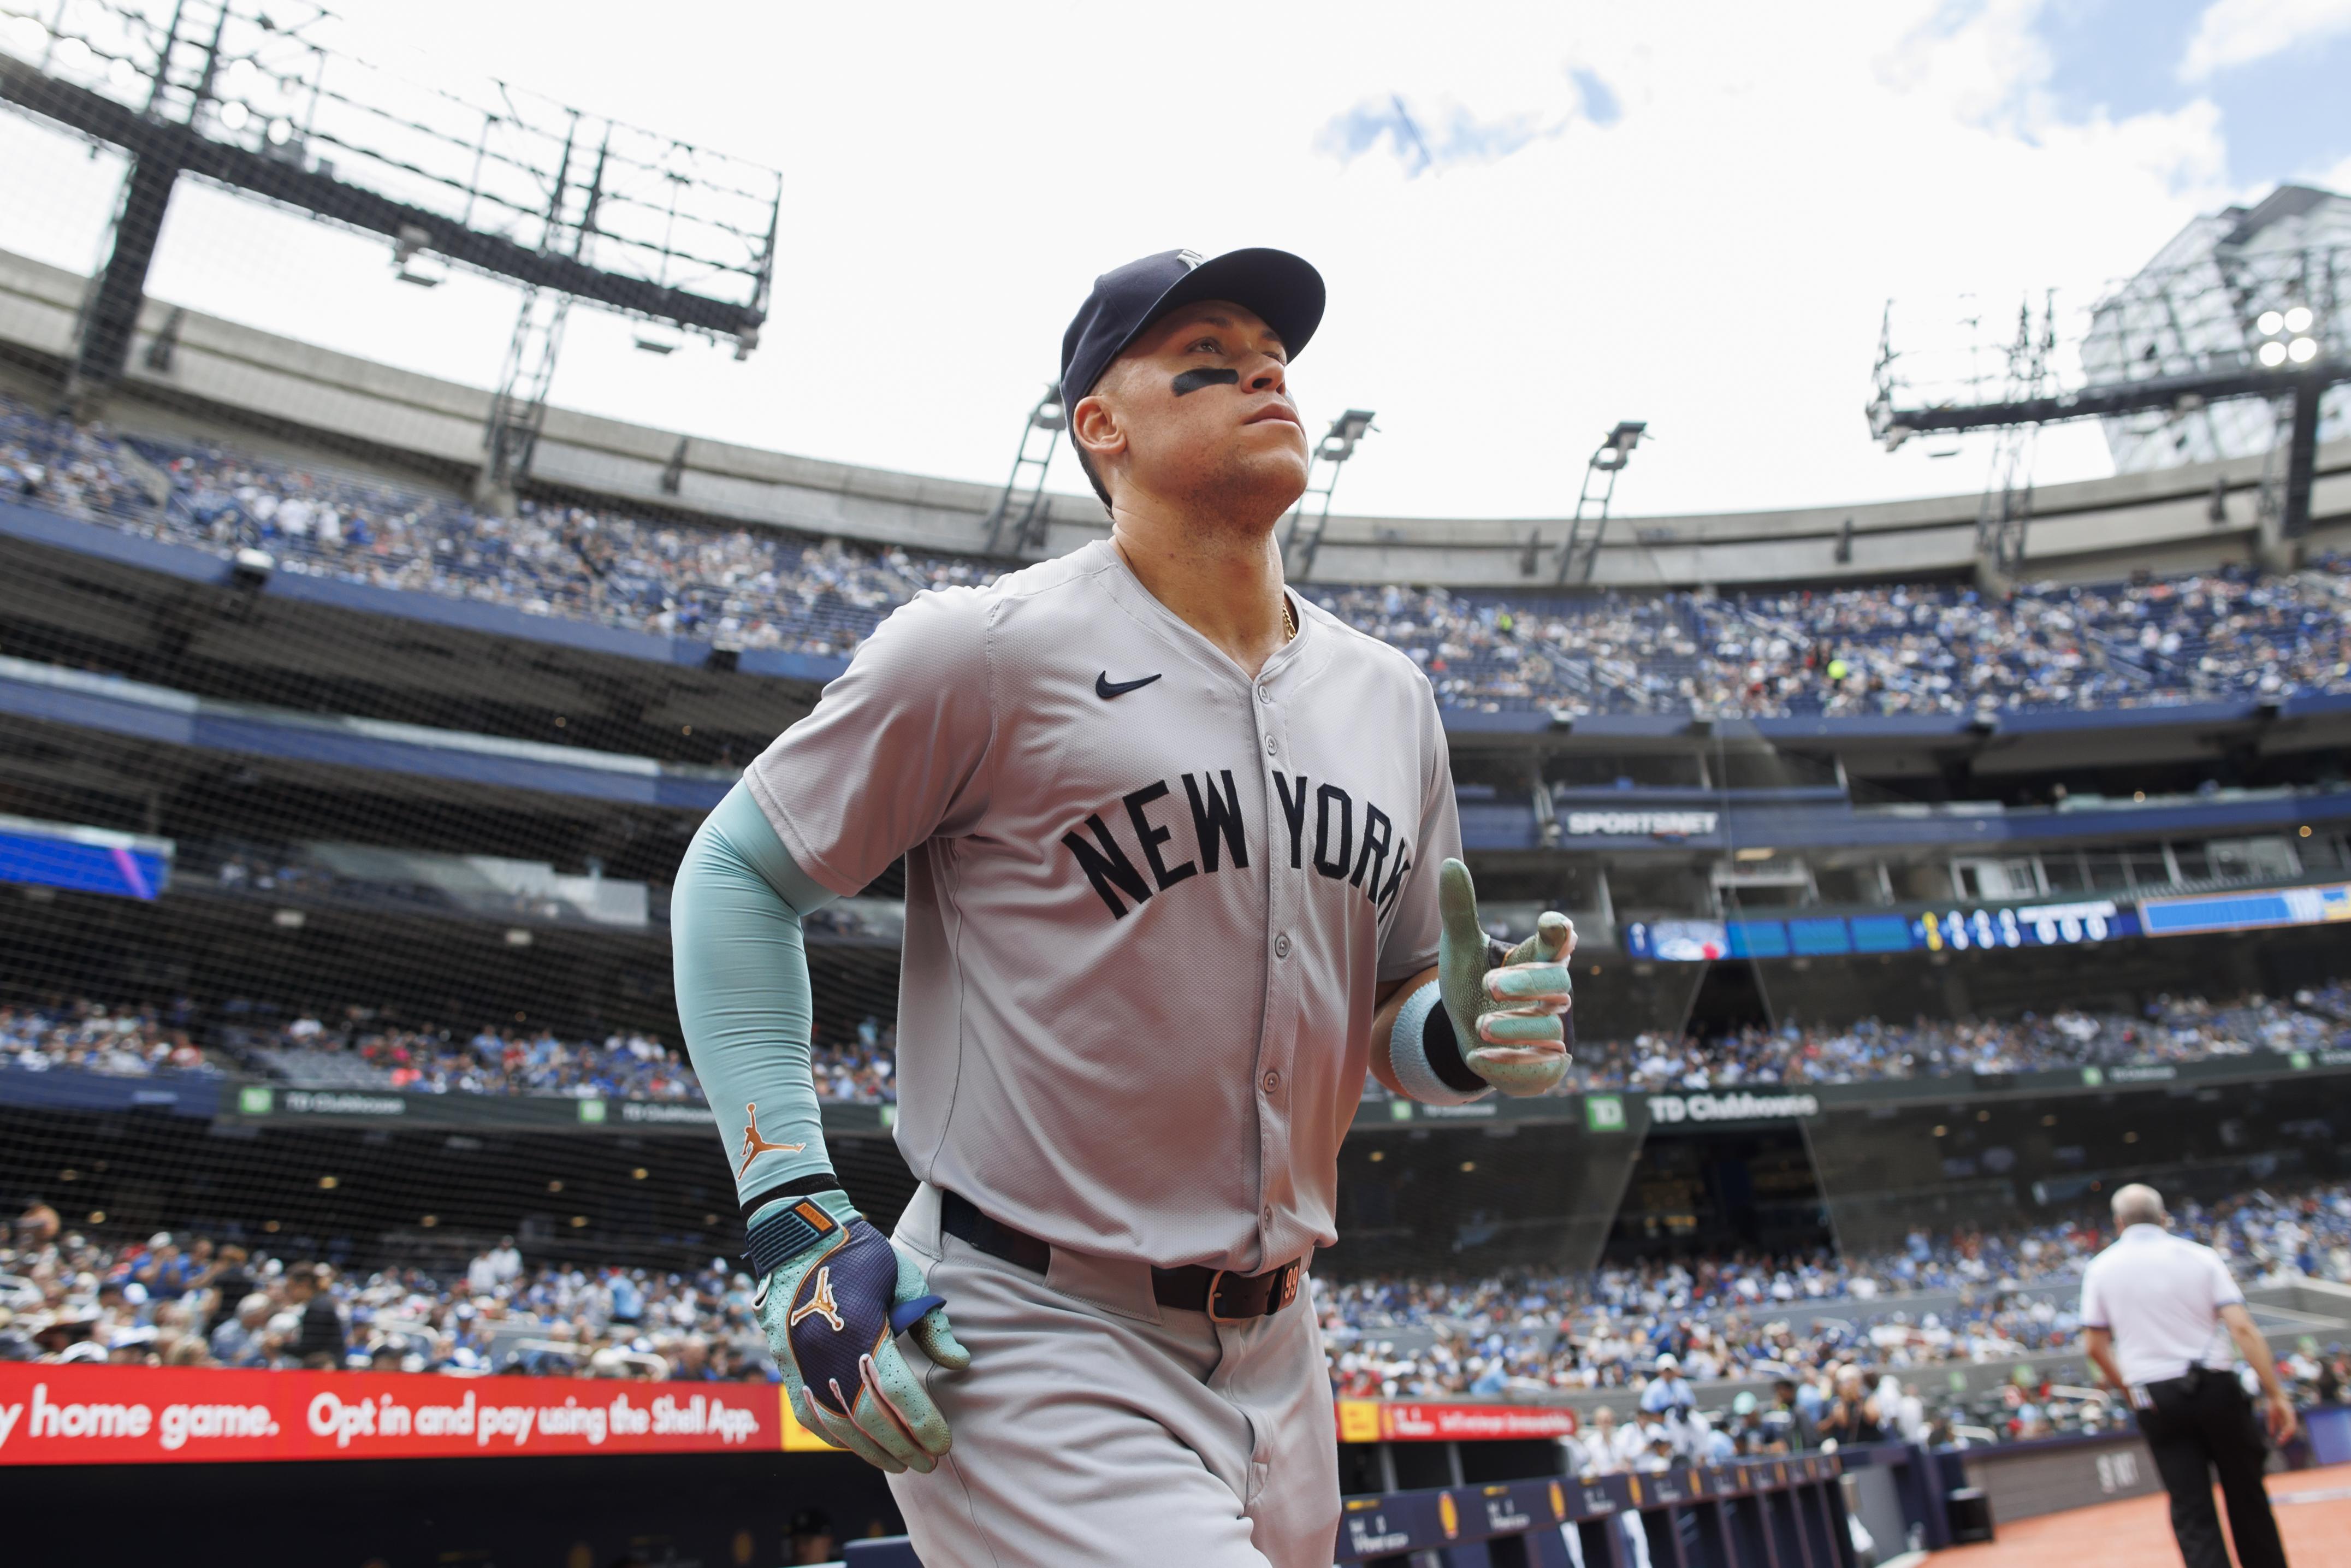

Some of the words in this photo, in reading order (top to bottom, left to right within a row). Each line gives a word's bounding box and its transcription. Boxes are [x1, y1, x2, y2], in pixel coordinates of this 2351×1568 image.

[1567, 812, 1719, 835] SPORTSNET
[1061, 770, 1249, 920] NEW
[1592, 1098, 1623, 1126] TD
[1646, 1096, 1686, 1123] TD
[1686, 1093, 1819, 1121] Clubhouse
[1284, 1266, 1299, 1299] 99
[29, 1382, 152, 1437] home
[159, 1404, 280, 1450] game.
[307, 1392, 377, 1448] Opt
[378, 1393, 411, 1436] in
[414, 1389, 476, 1436] and
[477, 1406, 536, 1447] pay
[538, 1395, 607, 1445] using
[609, 1393, 650, 1435] the
[652, 1393, 706, 1435] Shell
[707, 1398, 760, 1444] App.
